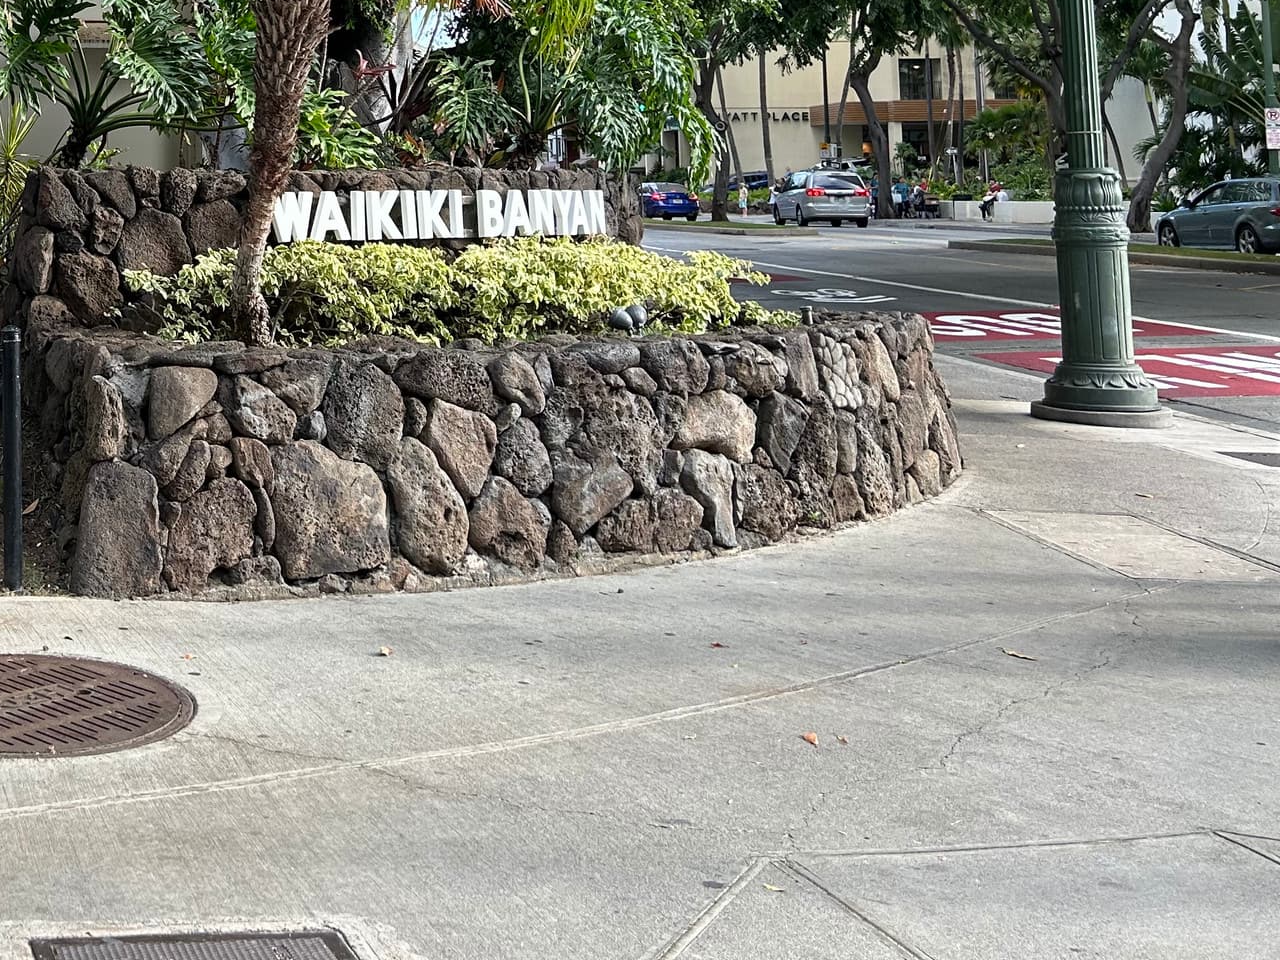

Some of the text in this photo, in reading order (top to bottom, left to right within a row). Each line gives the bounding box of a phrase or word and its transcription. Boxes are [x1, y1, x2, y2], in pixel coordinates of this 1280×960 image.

[719, 112, 758, 121] ATT
[273, 189, 606, 242] WAIKIKI BANYAN
